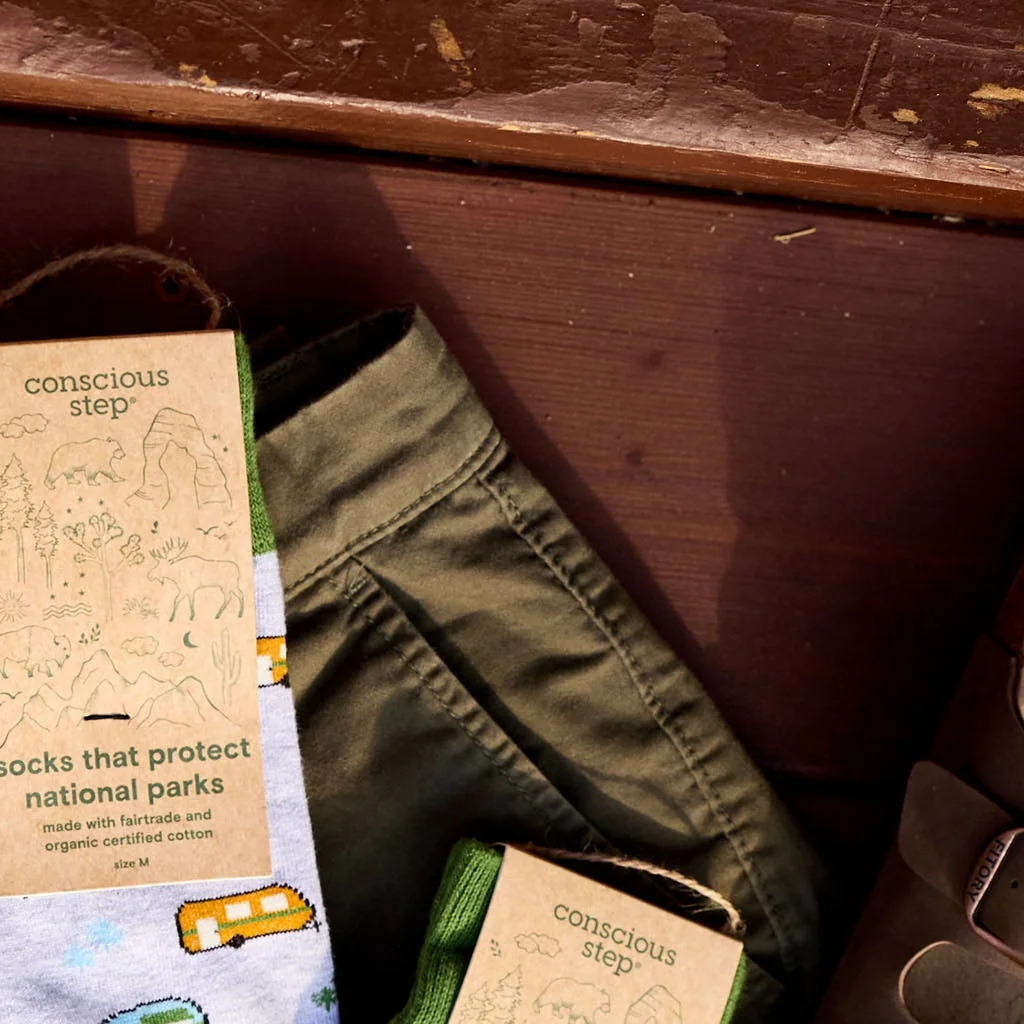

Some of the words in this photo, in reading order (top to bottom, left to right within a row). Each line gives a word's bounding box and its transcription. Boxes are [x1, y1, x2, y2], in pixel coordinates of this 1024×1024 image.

[24, 367, 170, 395] conscious
[70, 395, 130, 420] step
[82, 746, 139, 771] that
[148, 737, 251, 771] protect
[25, 778, 138, 809] national
[147, 773, 225, 805] parks
[42, 819, 82, 833] made
[86, 815, 116, 830] with
[119, 811, 181, 828] fairtrade
[185, 808, 212, 823] and
[44, 837, 98, 853] organic
[103, 831, 163, 847] certified
[167, 828, 214, 842] cotton
[113, 859, 136, 870] size
[138, 857, 150, 868] M
[553, 903, 677, 966] conscious
[581, 941, 634, 976] step
